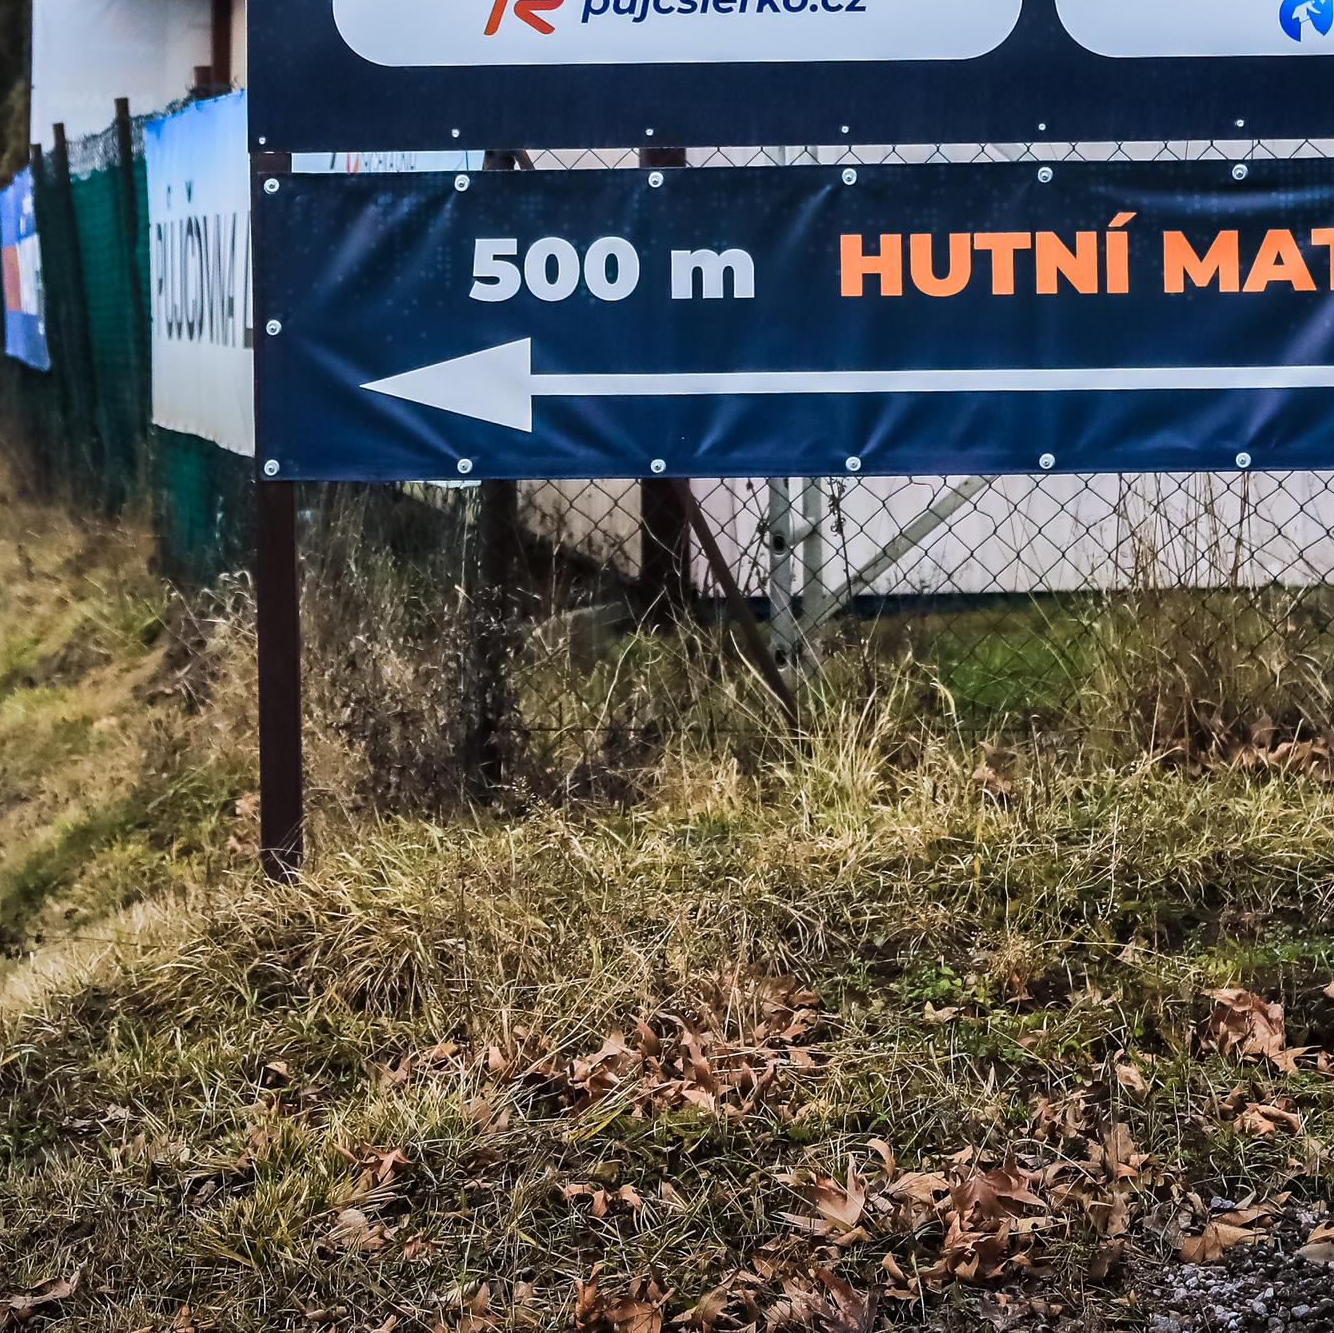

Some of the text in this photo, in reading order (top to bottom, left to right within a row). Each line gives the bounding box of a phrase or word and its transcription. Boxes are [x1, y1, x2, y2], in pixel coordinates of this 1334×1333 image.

[469, 236, 640, 302] 500
[671, 249, 754, 299] m
[839, 212, 1136, 297] HUTNÍ
